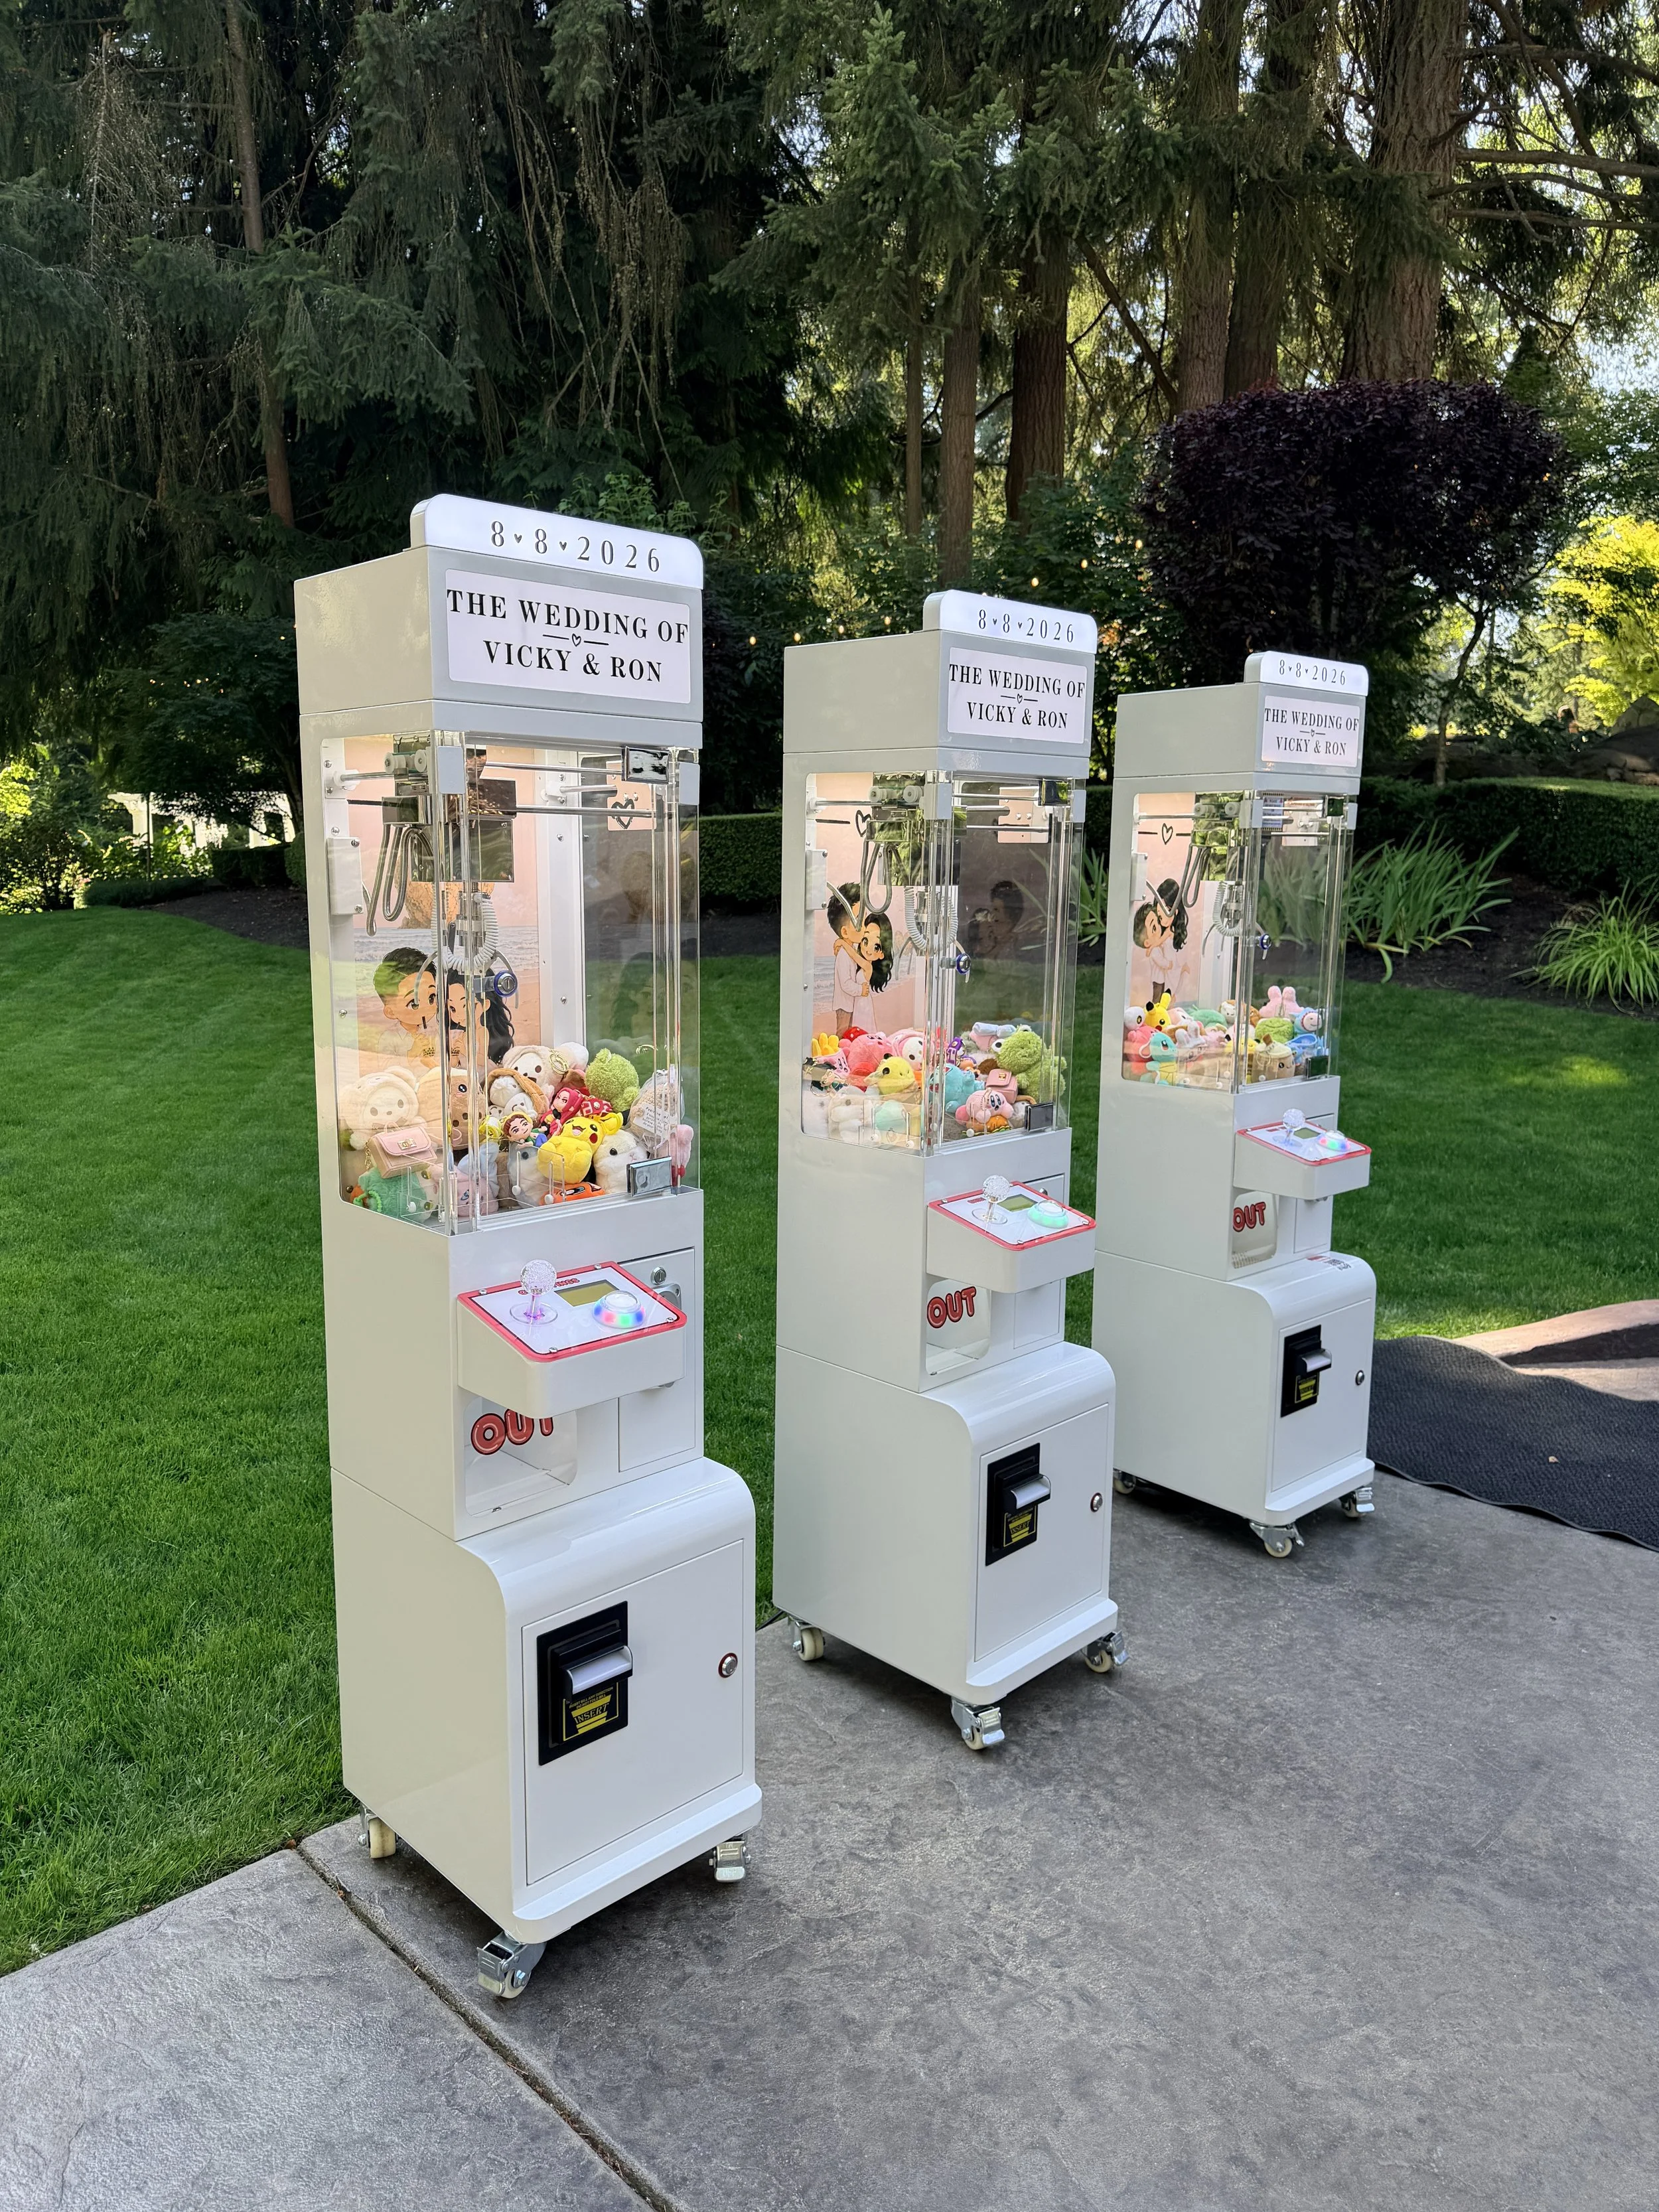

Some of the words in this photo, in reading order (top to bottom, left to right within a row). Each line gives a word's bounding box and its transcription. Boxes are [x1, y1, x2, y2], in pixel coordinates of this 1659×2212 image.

[447, 589, 506, 619] THE
[518, 599, 648, 639] WEDDING
[658, 621, 688, 644] OF
[483, 640, 571, 672] VICKY
[583, 653, 601, 676] &
[610, 656, 662, 683] RON
[949, 664, 982, 685] THE
[989, 669, 1061, 696] WEDDING
[1066, 680, 1085, 698] OF
[967, 701, 1017, 723] VICKY
[1022, 708, 1033, 725] &
[1037, 710, 1068, 729] RON
[1264, 707, 1287, 723] THE
[1291, 711, 1342, 731] WEDDING
[1346, 717, 1359, 731] OF
[1276, 736, 1311, 753] VICKY
[1313, 740, 1321, 754] &
[1325, 741, 1346, 755] RON
[1233, 1201, 1266, 1232] OUT
[927, 1286, 976, 1329] OUT
[574, 1702, 609, 1724] INSERT
